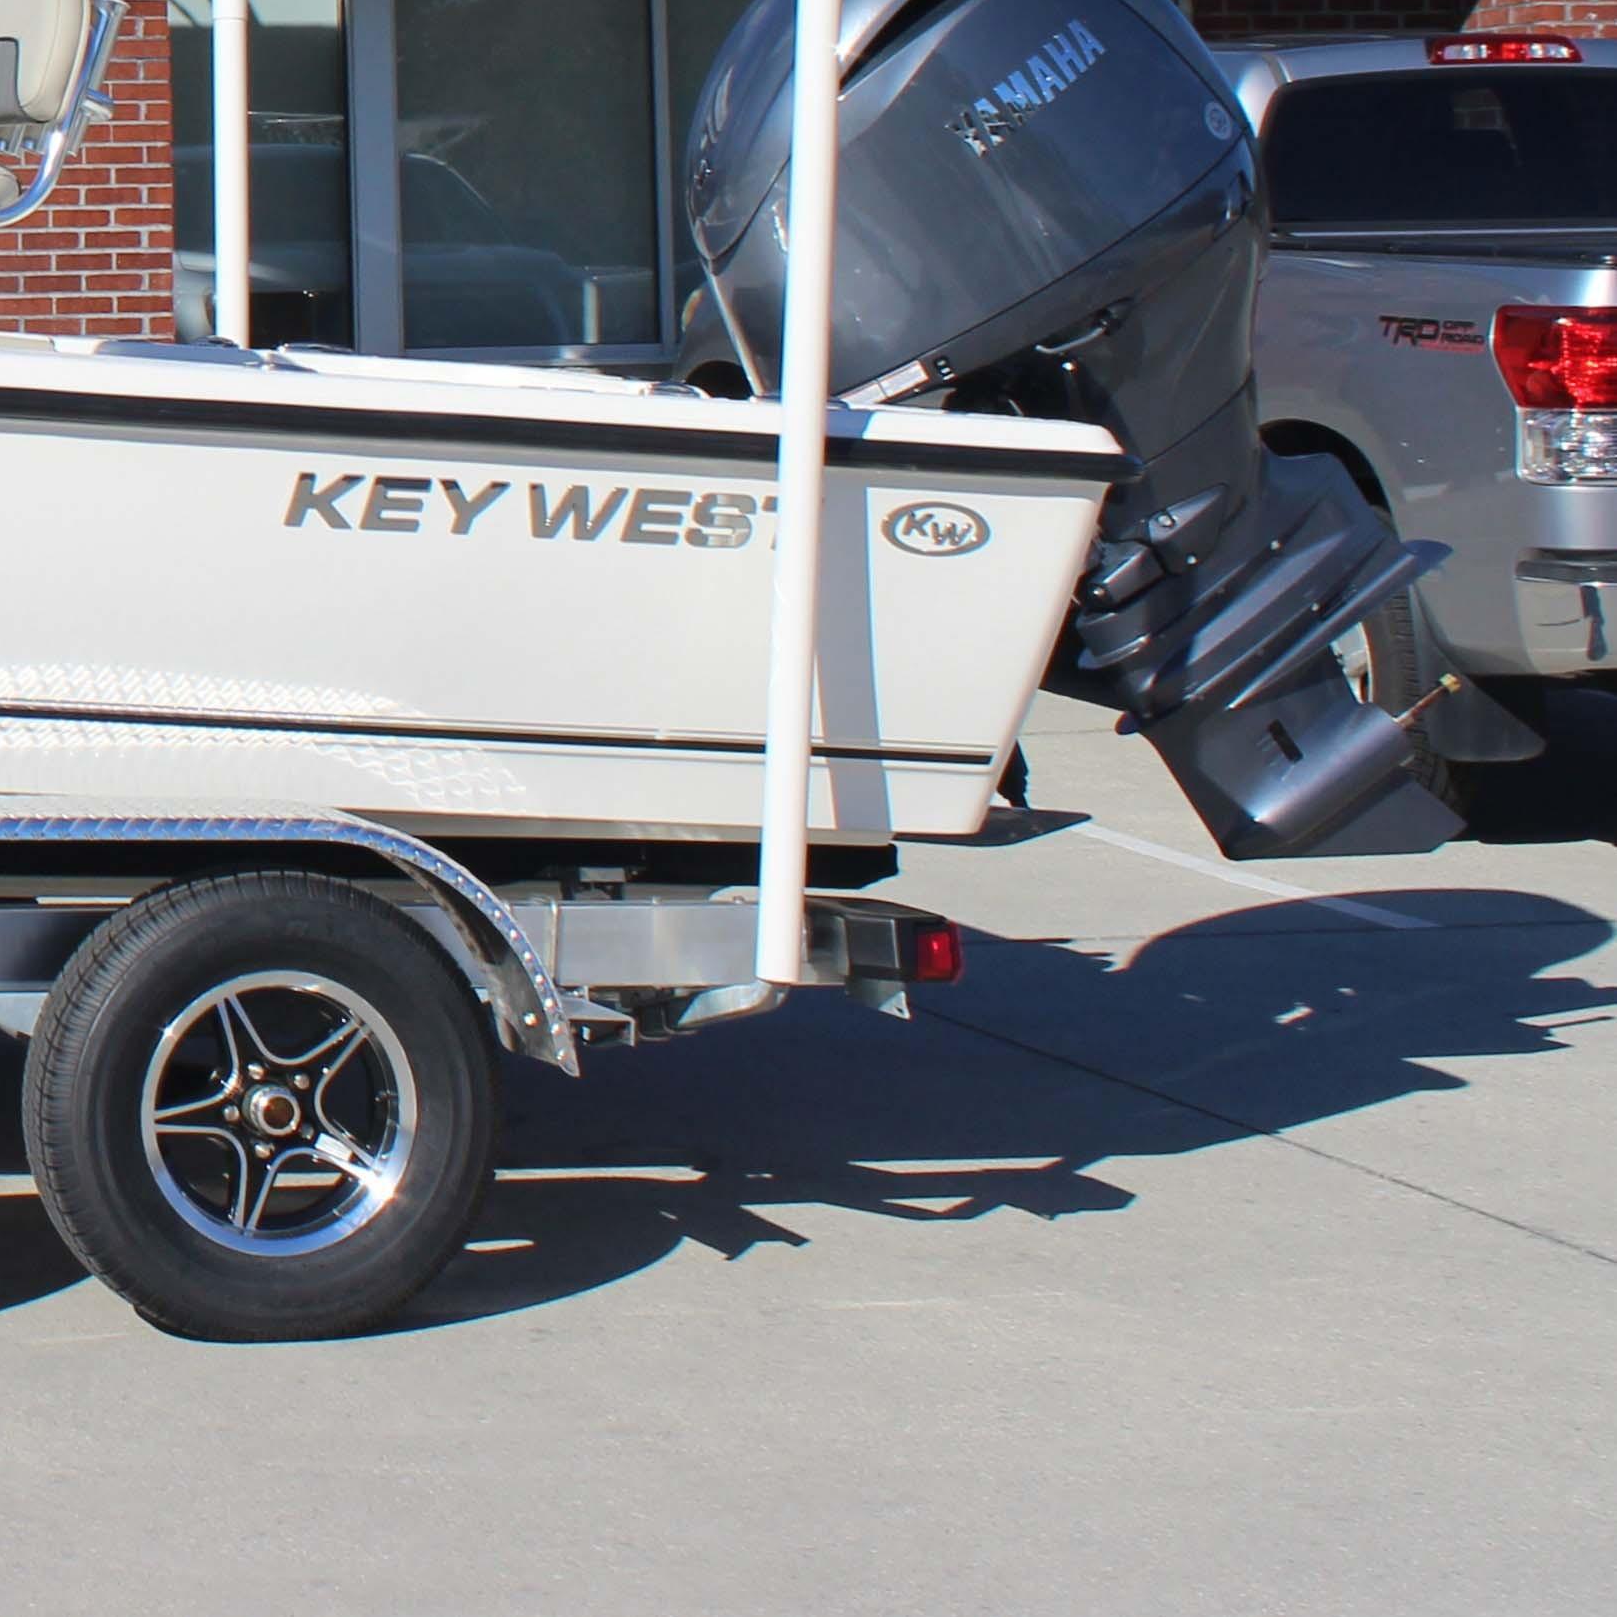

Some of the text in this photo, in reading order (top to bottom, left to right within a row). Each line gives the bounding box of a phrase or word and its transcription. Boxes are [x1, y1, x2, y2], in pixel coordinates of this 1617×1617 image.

[944, 18, 1106, 157] YAMAHA
[1379, 314, 1441, 346] TRD
[283, 471, 778, 550] KEY WES
[902, 511, 972, 546] KW
